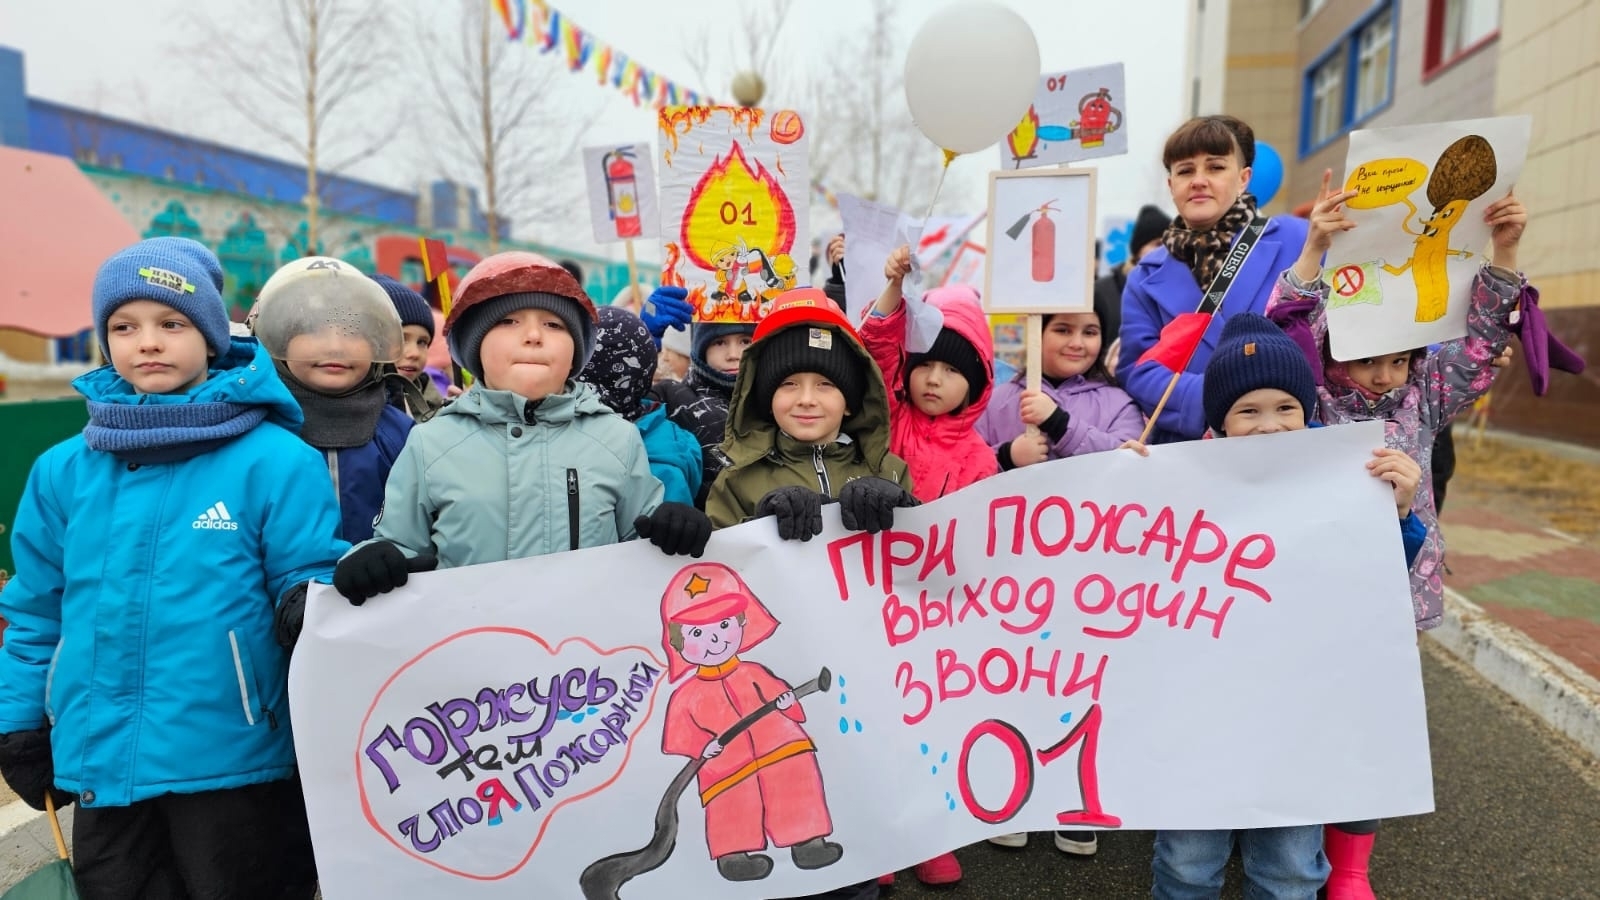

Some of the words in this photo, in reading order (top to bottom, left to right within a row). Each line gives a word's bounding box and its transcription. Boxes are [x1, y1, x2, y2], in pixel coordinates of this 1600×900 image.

[1046, 74, 1067, 92] 01
[1361, 185, 1371, 194] не
[720, 201, 757, 225] 01
[1222, 242, 1250, 279] GUESS
[152, 269, 183, 284] HAND
[192, 518, 239, 531] adidas
[827, 518, 956, 600] ПРИ
[957, 703, 1123, 828] 01
